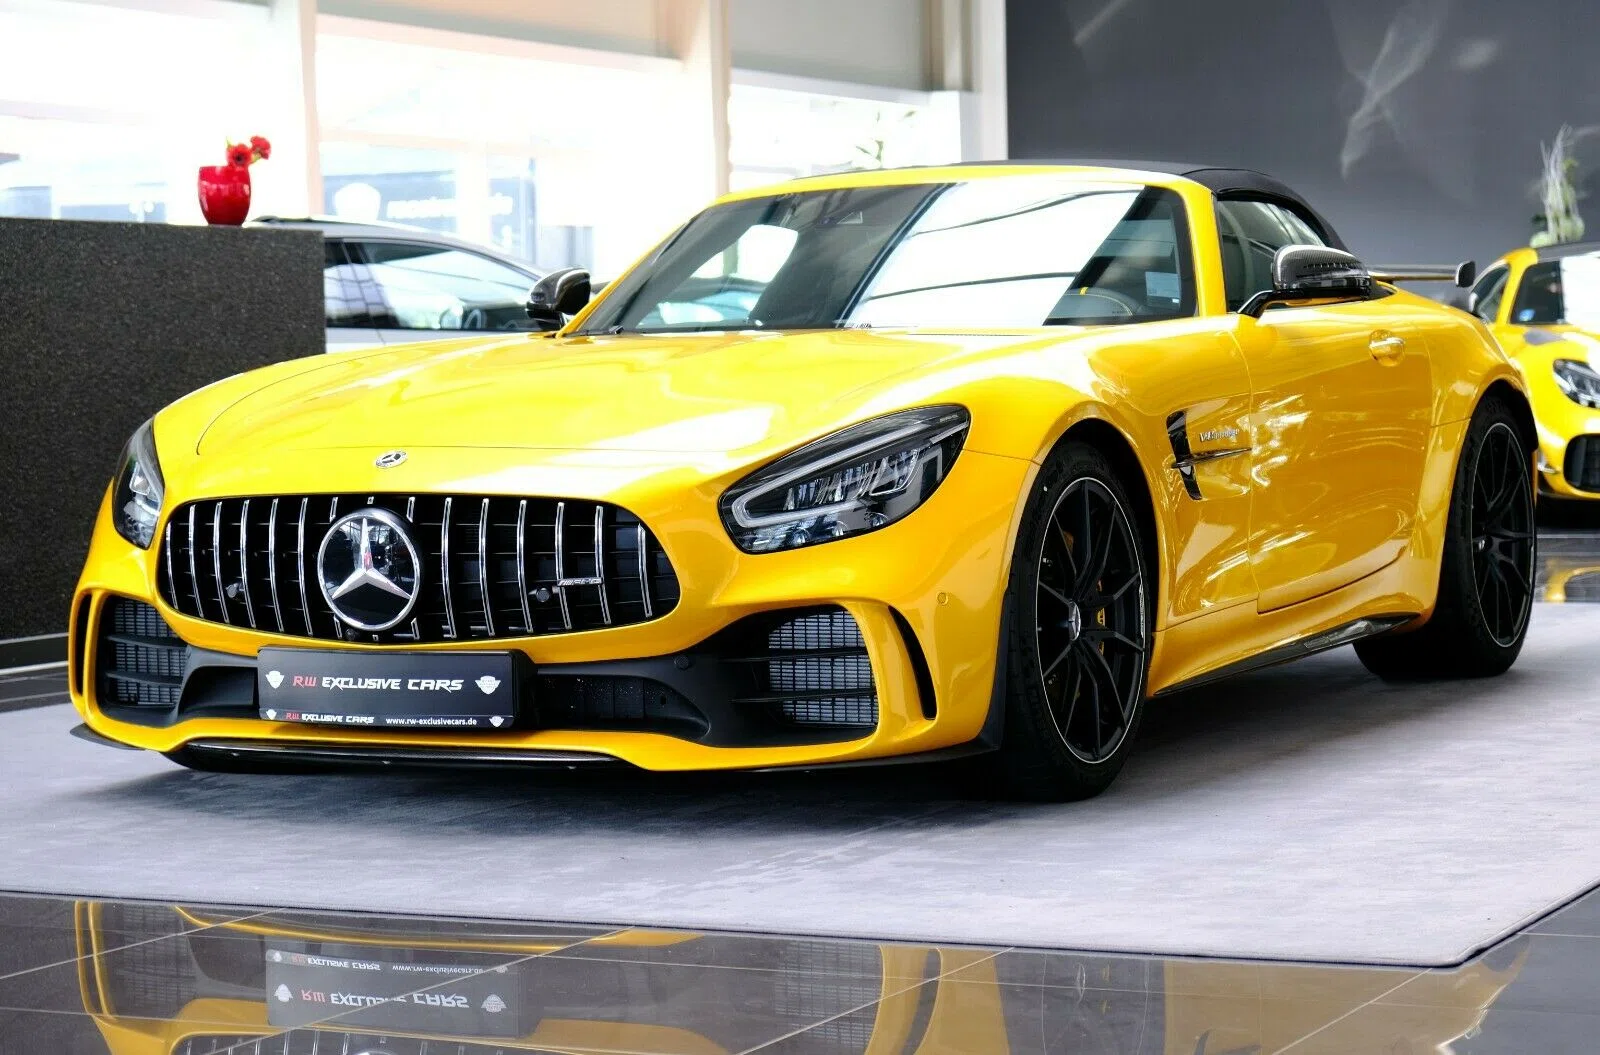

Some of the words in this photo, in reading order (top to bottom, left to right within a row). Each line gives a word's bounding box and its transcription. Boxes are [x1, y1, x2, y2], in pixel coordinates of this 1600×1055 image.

[292, 675, 317, 688] RW
[321, 676, 402, 691] EXCLUSIVE
[407, 679, 464, 693] CARS
[285, 712, 300, 720] RW
[301, 713, 343, 723] EXCLUSIVE
[345, 715, 375, 725] CARS
[385, 717, 478, 726] www.rw-exclusivecars.de
